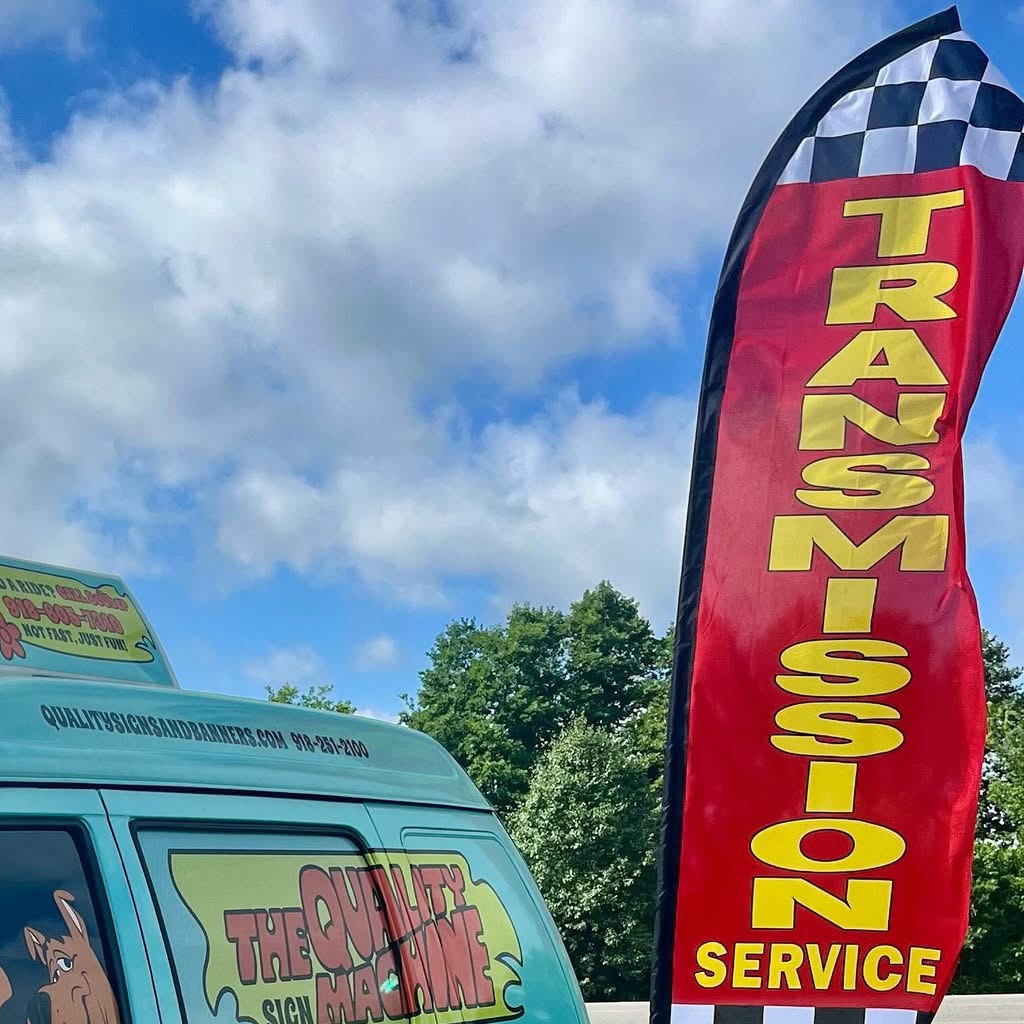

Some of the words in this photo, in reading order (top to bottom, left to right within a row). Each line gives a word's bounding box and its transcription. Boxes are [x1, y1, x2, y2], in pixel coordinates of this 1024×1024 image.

[6, 578, 19, 592] A
[17, 580, 56, 599] RIDE?
[751, 189, 965, 932] TRANSMISSION
[20, 623, 49, 640] NOT
[77, 632, 104, 648] JUST
[102, 636, 128, 652] FUN!
[39, 703, 289, 751] QUALITYSIGNSANDBANNERS.COM
[290, 731, 370, 760] 918-251-2100
[223, 906, 313, 986] THE
[299, 863, 468, 976] QUALITY
[694, 941, 942, 996] SERVICE
